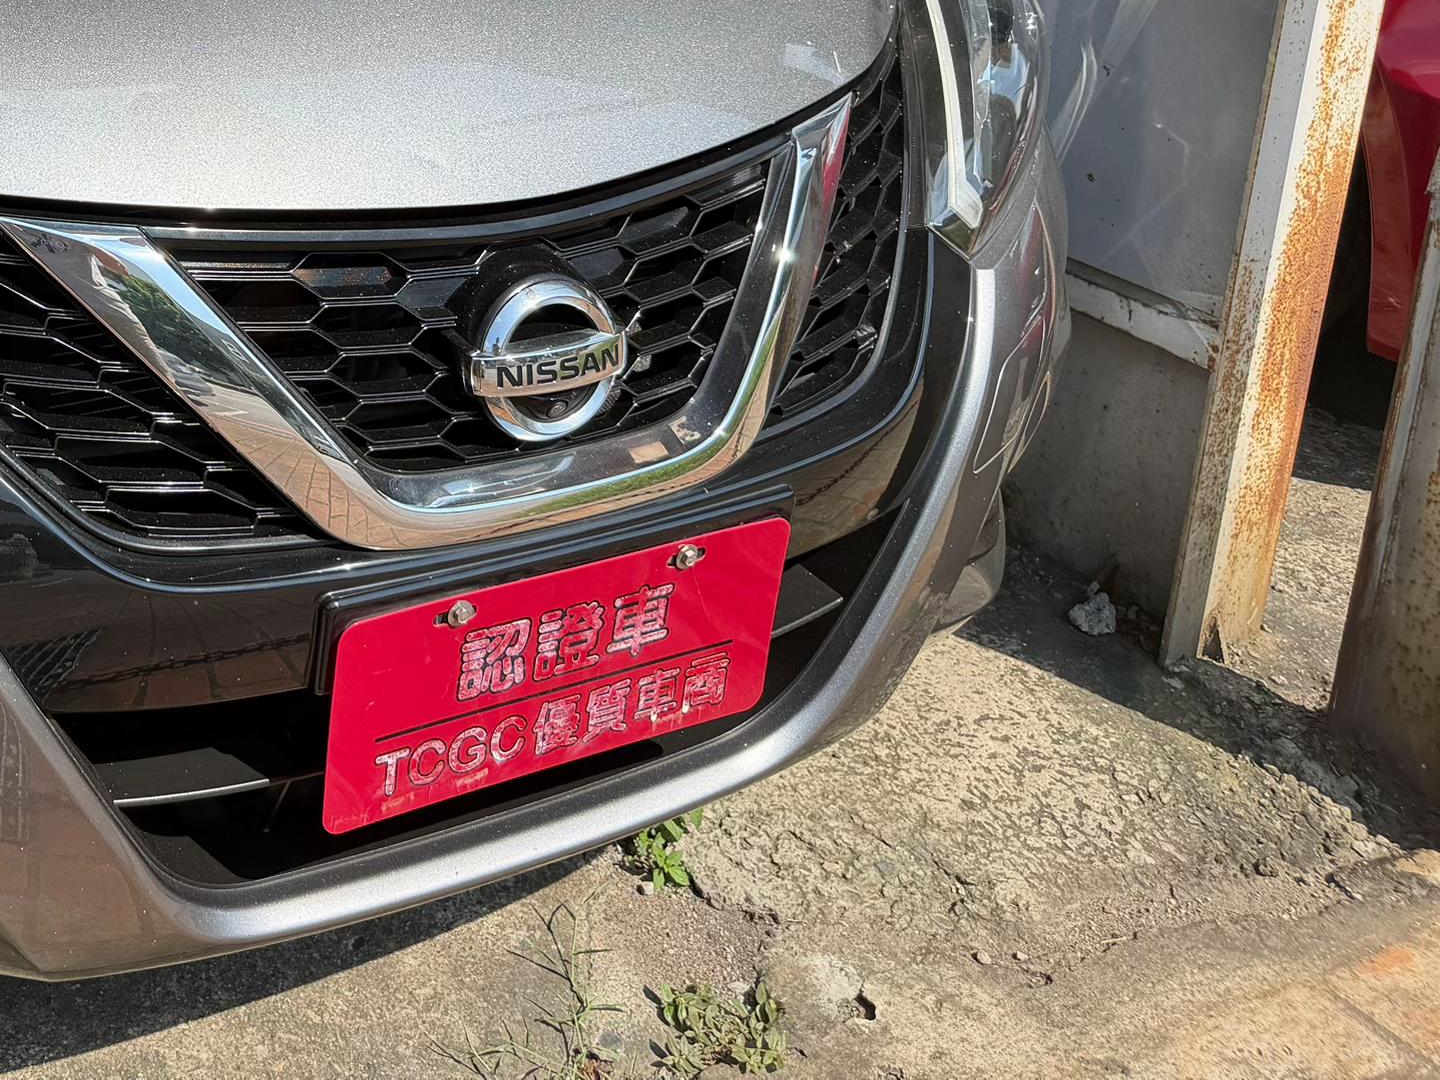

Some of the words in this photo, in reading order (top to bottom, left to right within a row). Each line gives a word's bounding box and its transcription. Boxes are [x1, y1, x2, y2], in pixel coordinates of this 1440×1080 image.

[496, 342, 620, 389] NISSAN
[456, 582, 676, 703] 認證車
